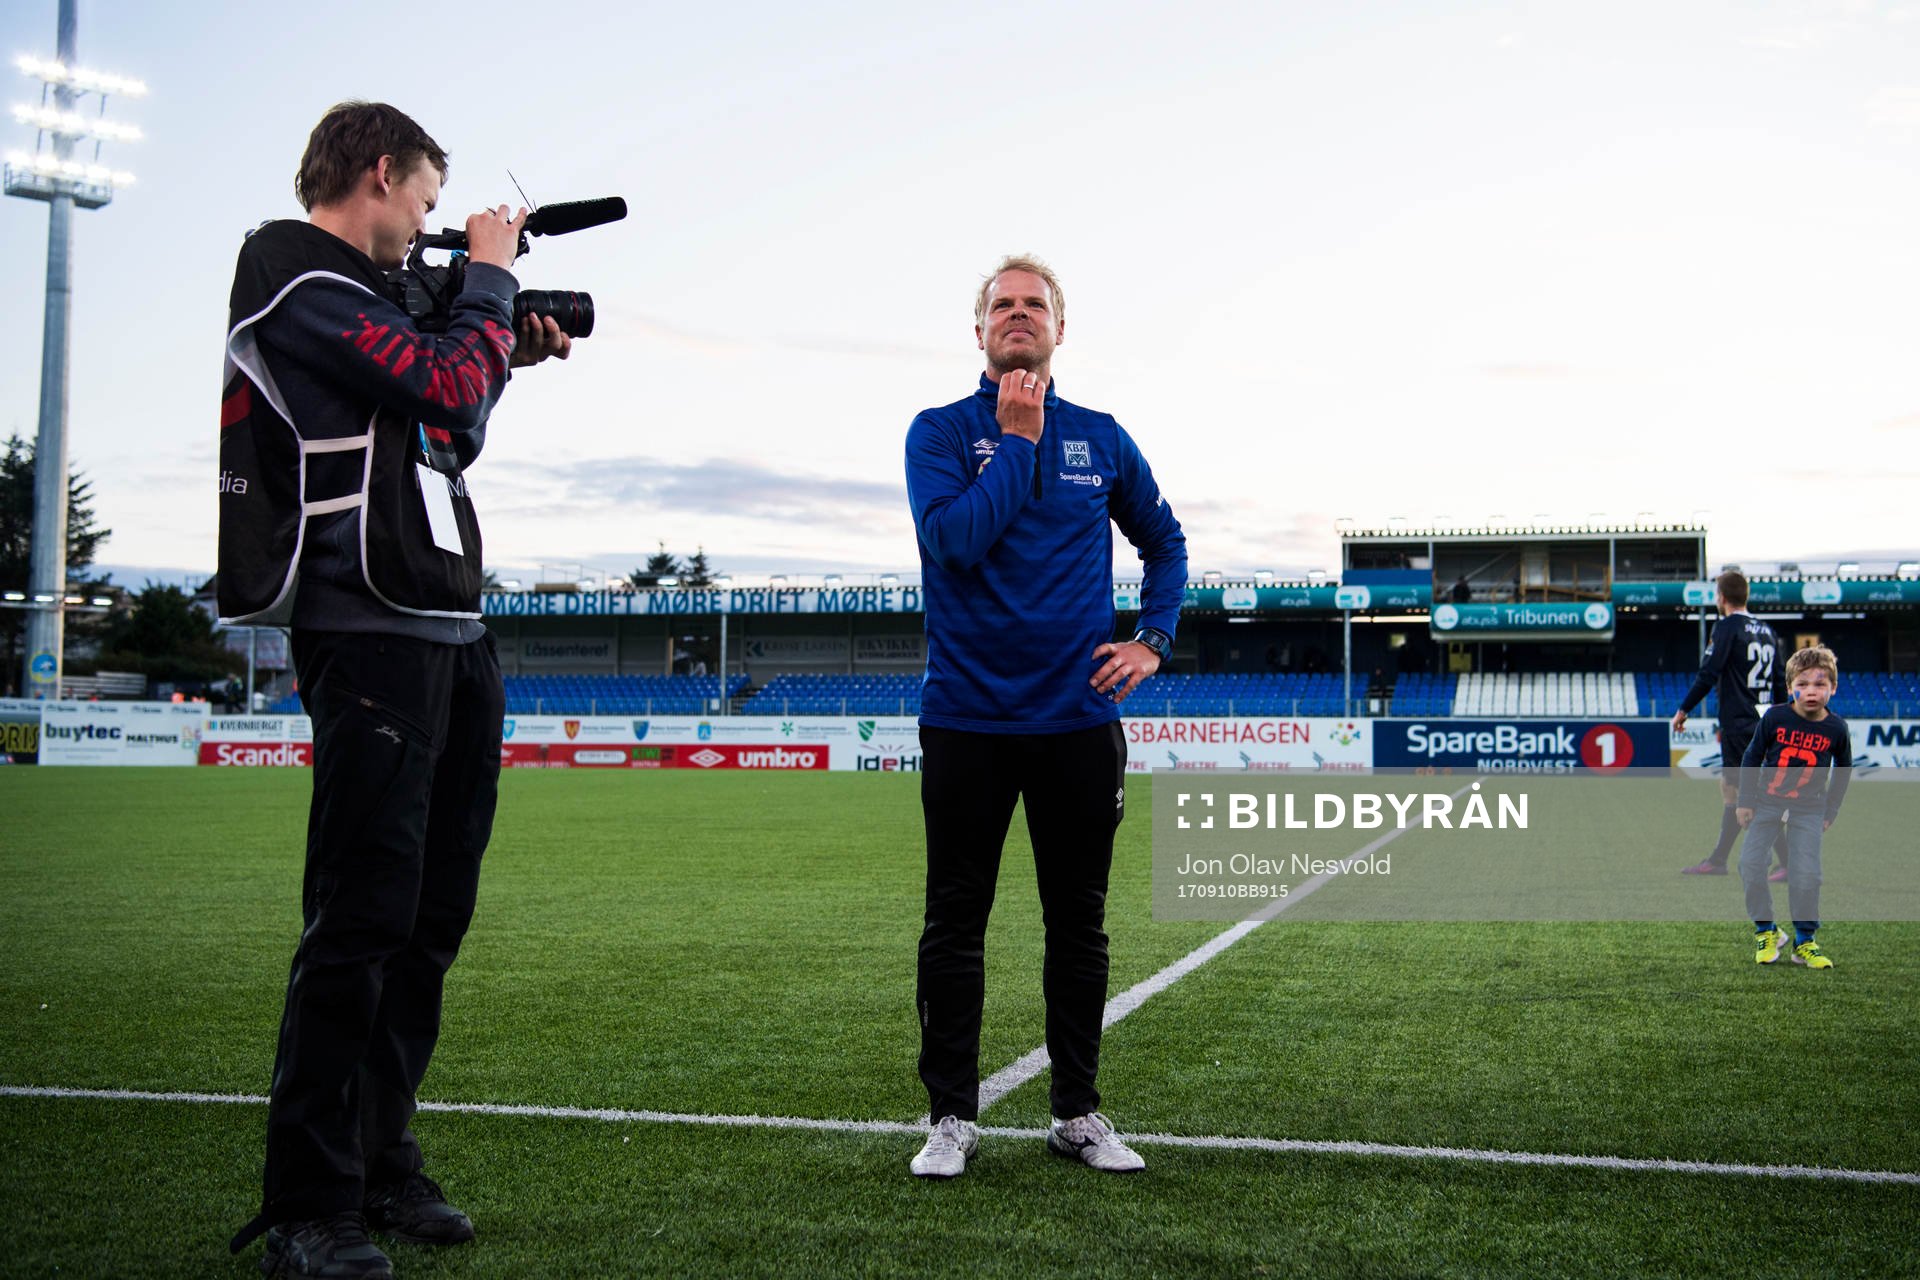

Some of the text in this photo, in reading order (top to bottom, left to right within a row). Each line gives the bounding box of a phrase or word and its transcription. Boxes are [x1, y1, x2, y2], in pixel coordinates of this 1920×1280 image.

[485, 591, 925, 615] MØRE DRIFT MØRE DRIFT MØRE D
[1505, 609, 1580, 625] Tribunen
[1747, 641, 1775, 690] 22
[45, 724, 121, 742] buytec
[126, 735, 179, 744] MALTHUS
[217, 743, 307, 767] Scandic
[1406, 724, 1616, 767] SpareBank 1
[737, 747, 816, 768] umbro
[1477, 759, 1578, 774] NORDVEST
